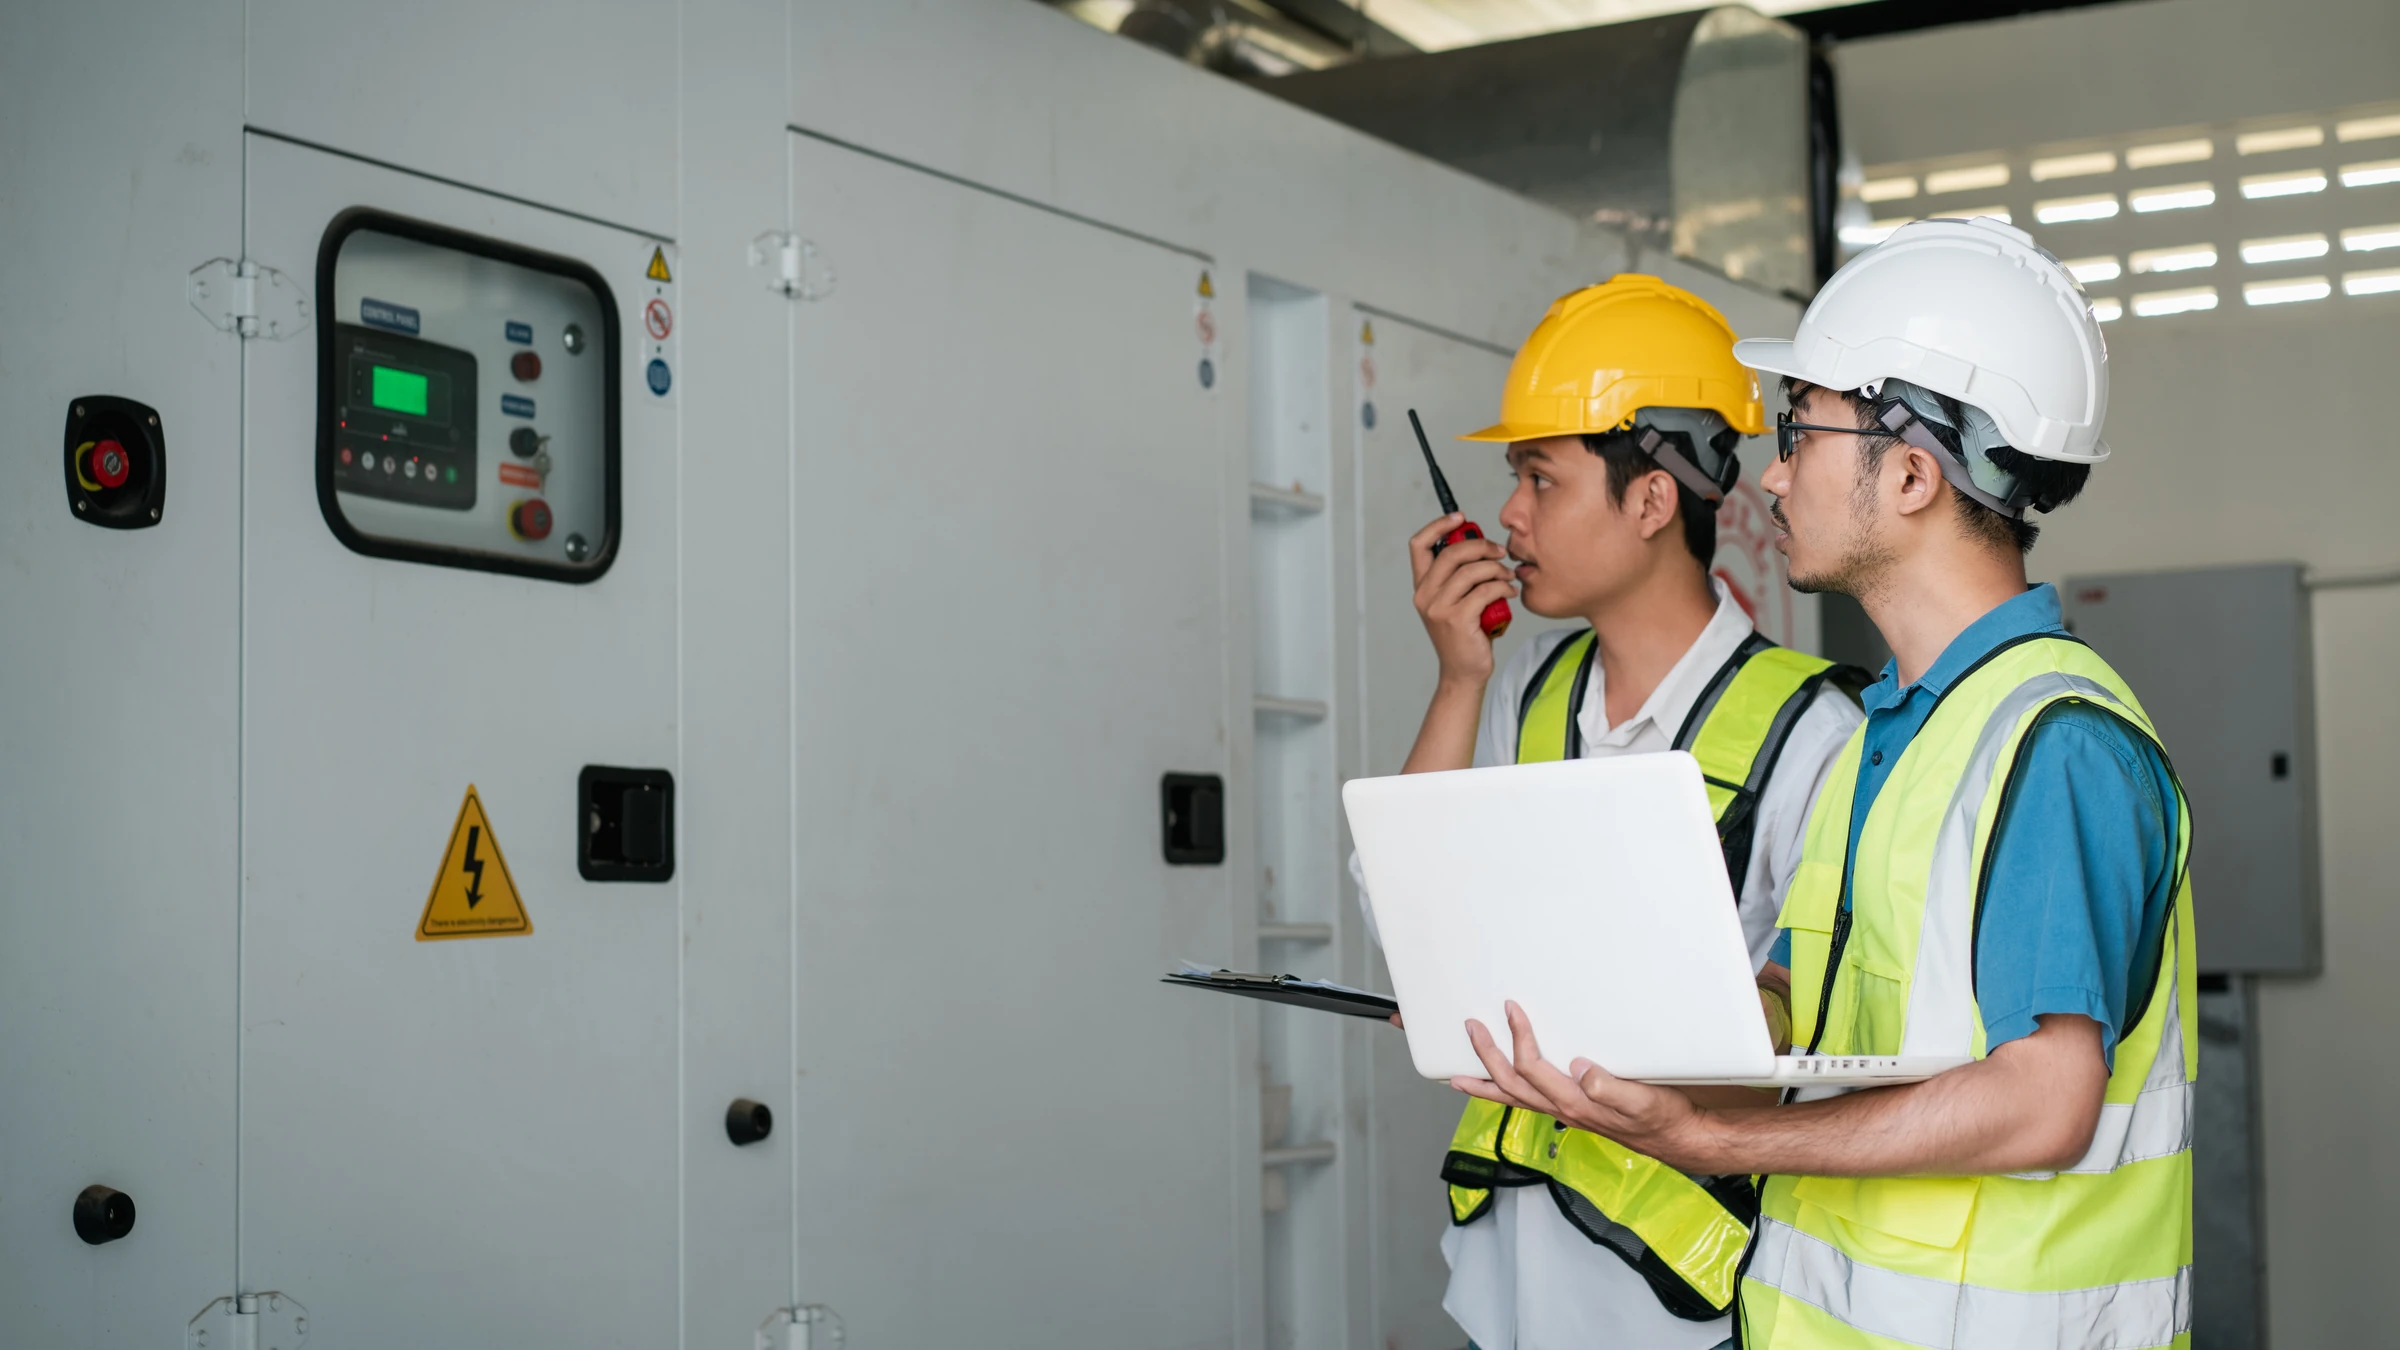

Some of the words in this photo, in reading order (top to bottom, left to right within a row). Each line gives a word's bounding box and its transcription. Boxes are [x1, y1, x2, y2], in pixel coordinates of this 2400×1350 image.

[363, 304, 395, 324] CONTROL
[396, 312, 418, 330] PANEL
[431, 918, 449, 926] There
